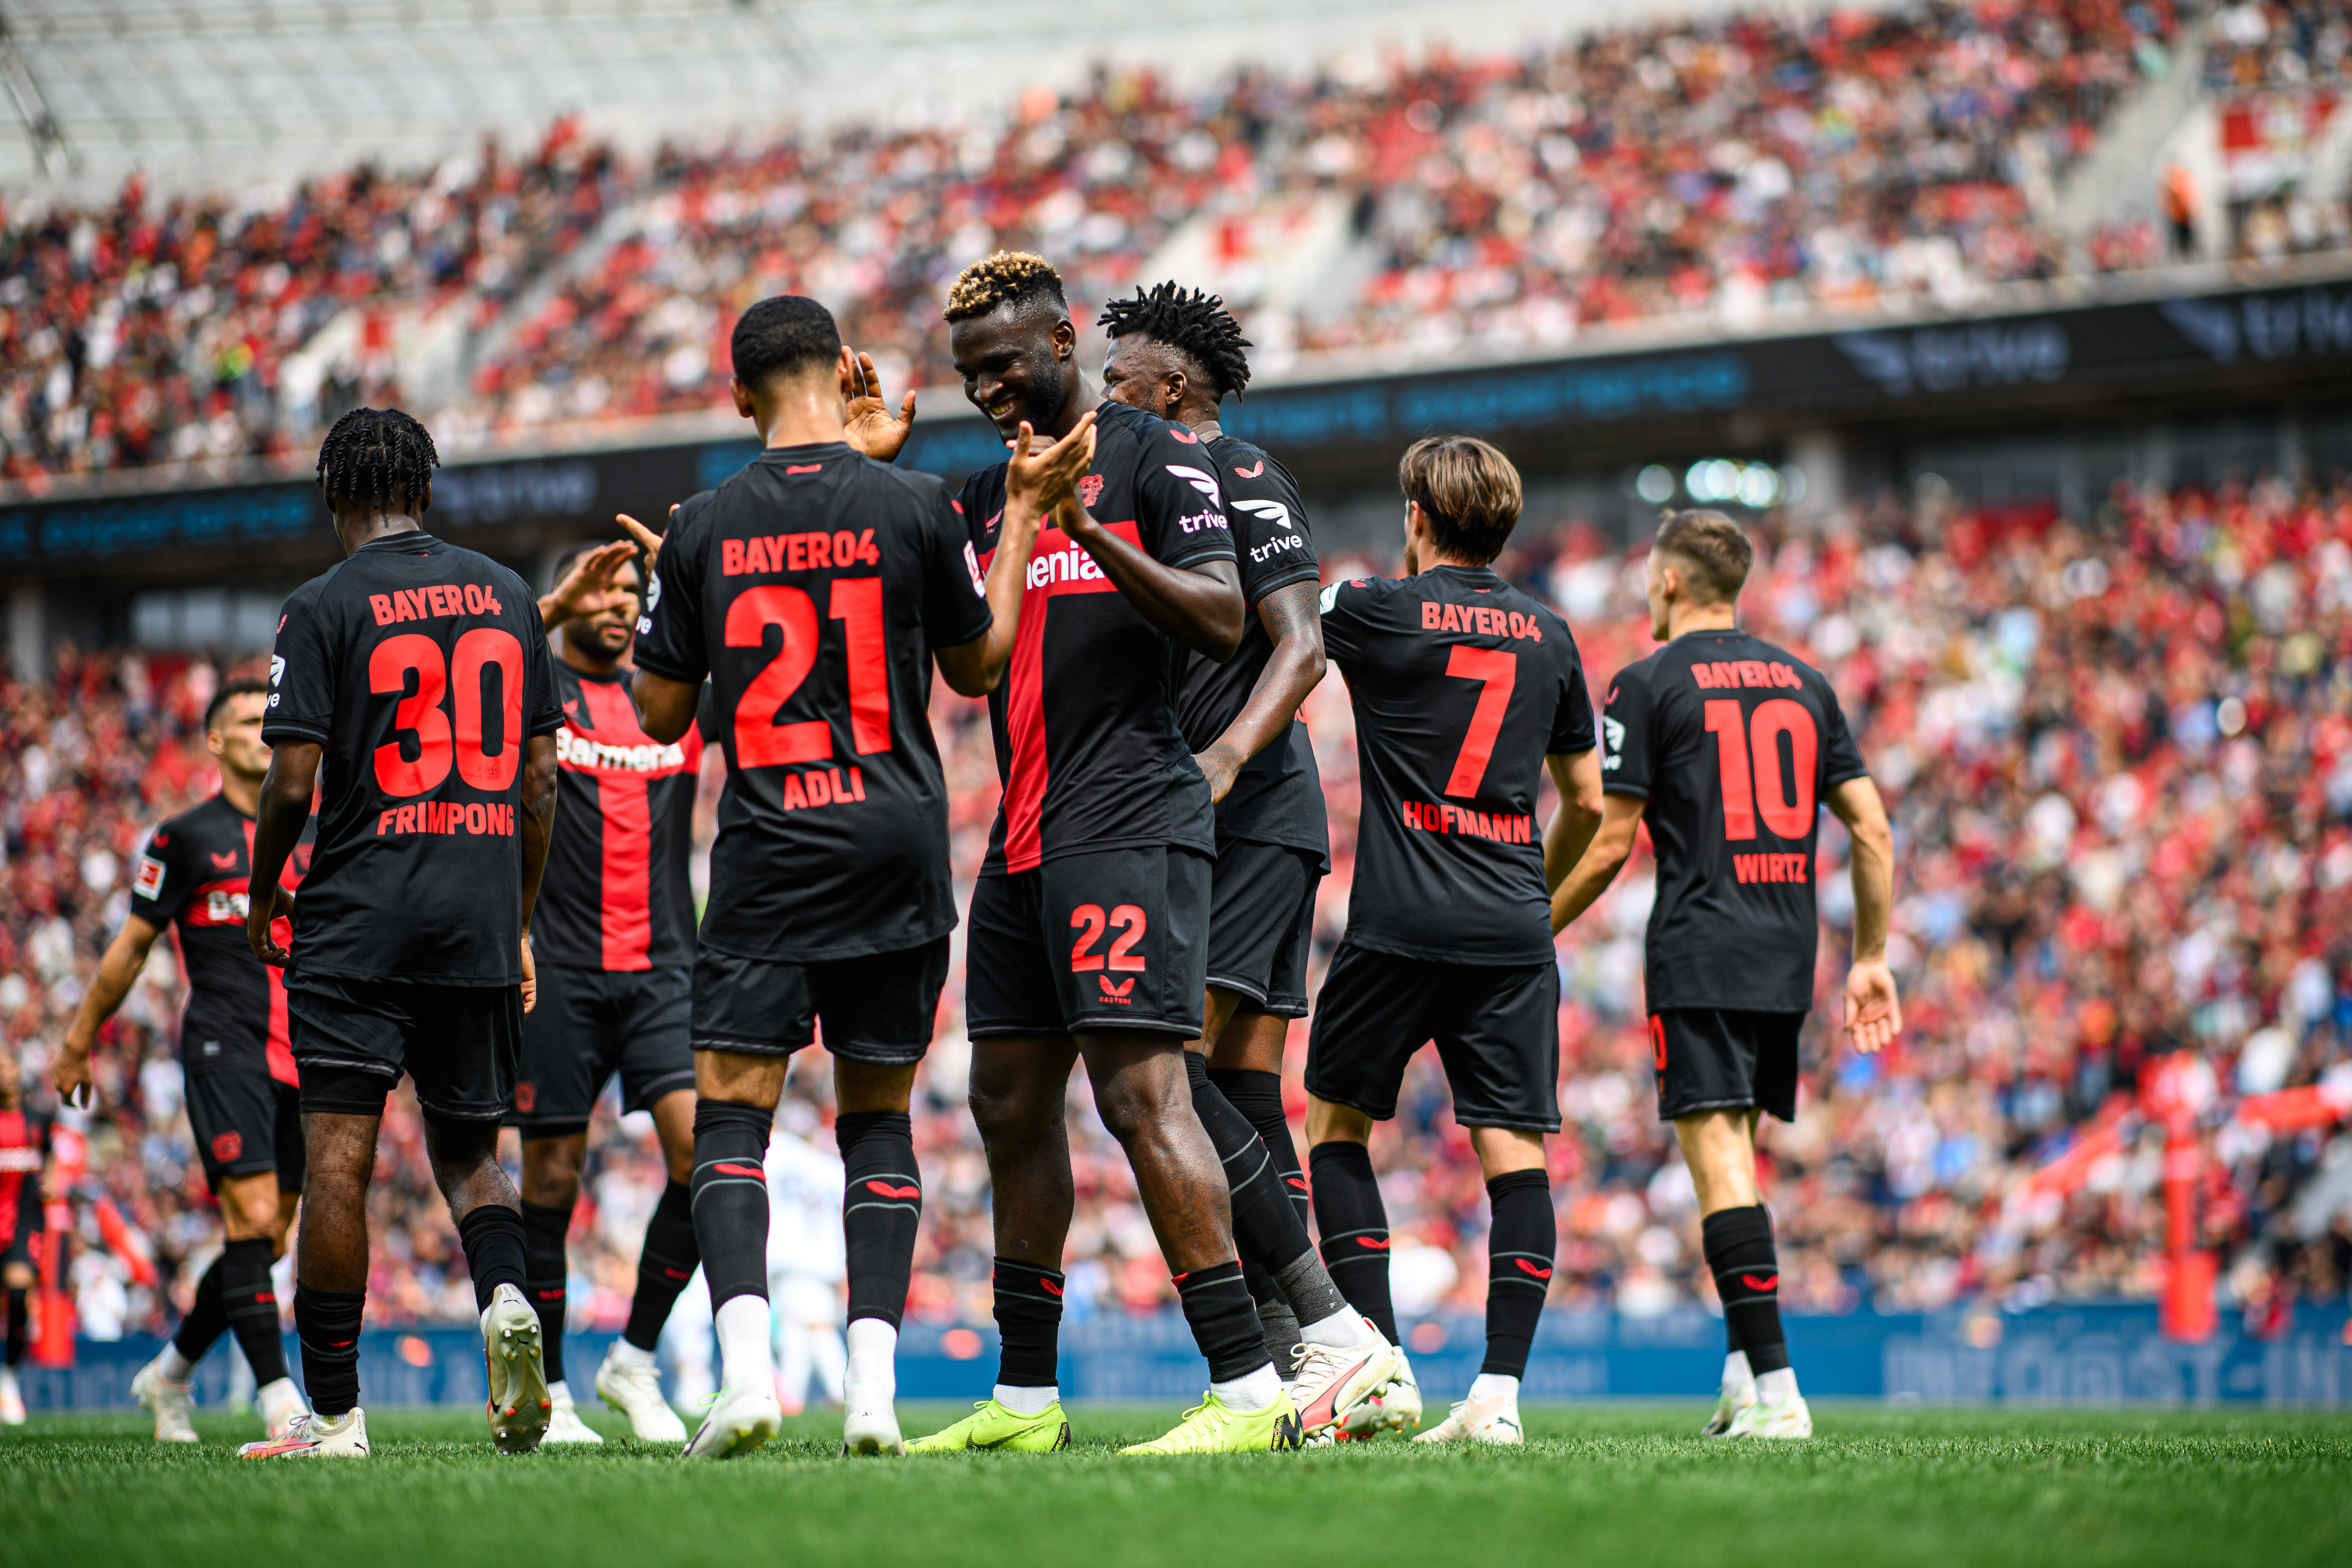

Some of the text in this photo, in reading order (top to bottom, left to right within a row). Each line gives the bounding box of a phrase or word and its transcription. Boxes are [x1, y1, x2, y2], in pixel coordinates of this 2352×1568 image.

[1179, 509, 1228, 533] trive
[1250, 535, 1303, 562] trive
[725, 577, 892, 769] 21
[369, 627, 524, 797] 30
[1444, 644, 1517, 798] 7
[784, 766, 866, 811] ADLI
[1705, 698, 1818, 841] 10
[376, 801, 514, 837] FRIMPONG
[1403, 800, 1531, 845] HOFMANN
[1733, 853, 1808, 884] WIRTZ
[1070, 904, 1147, 972] 22
